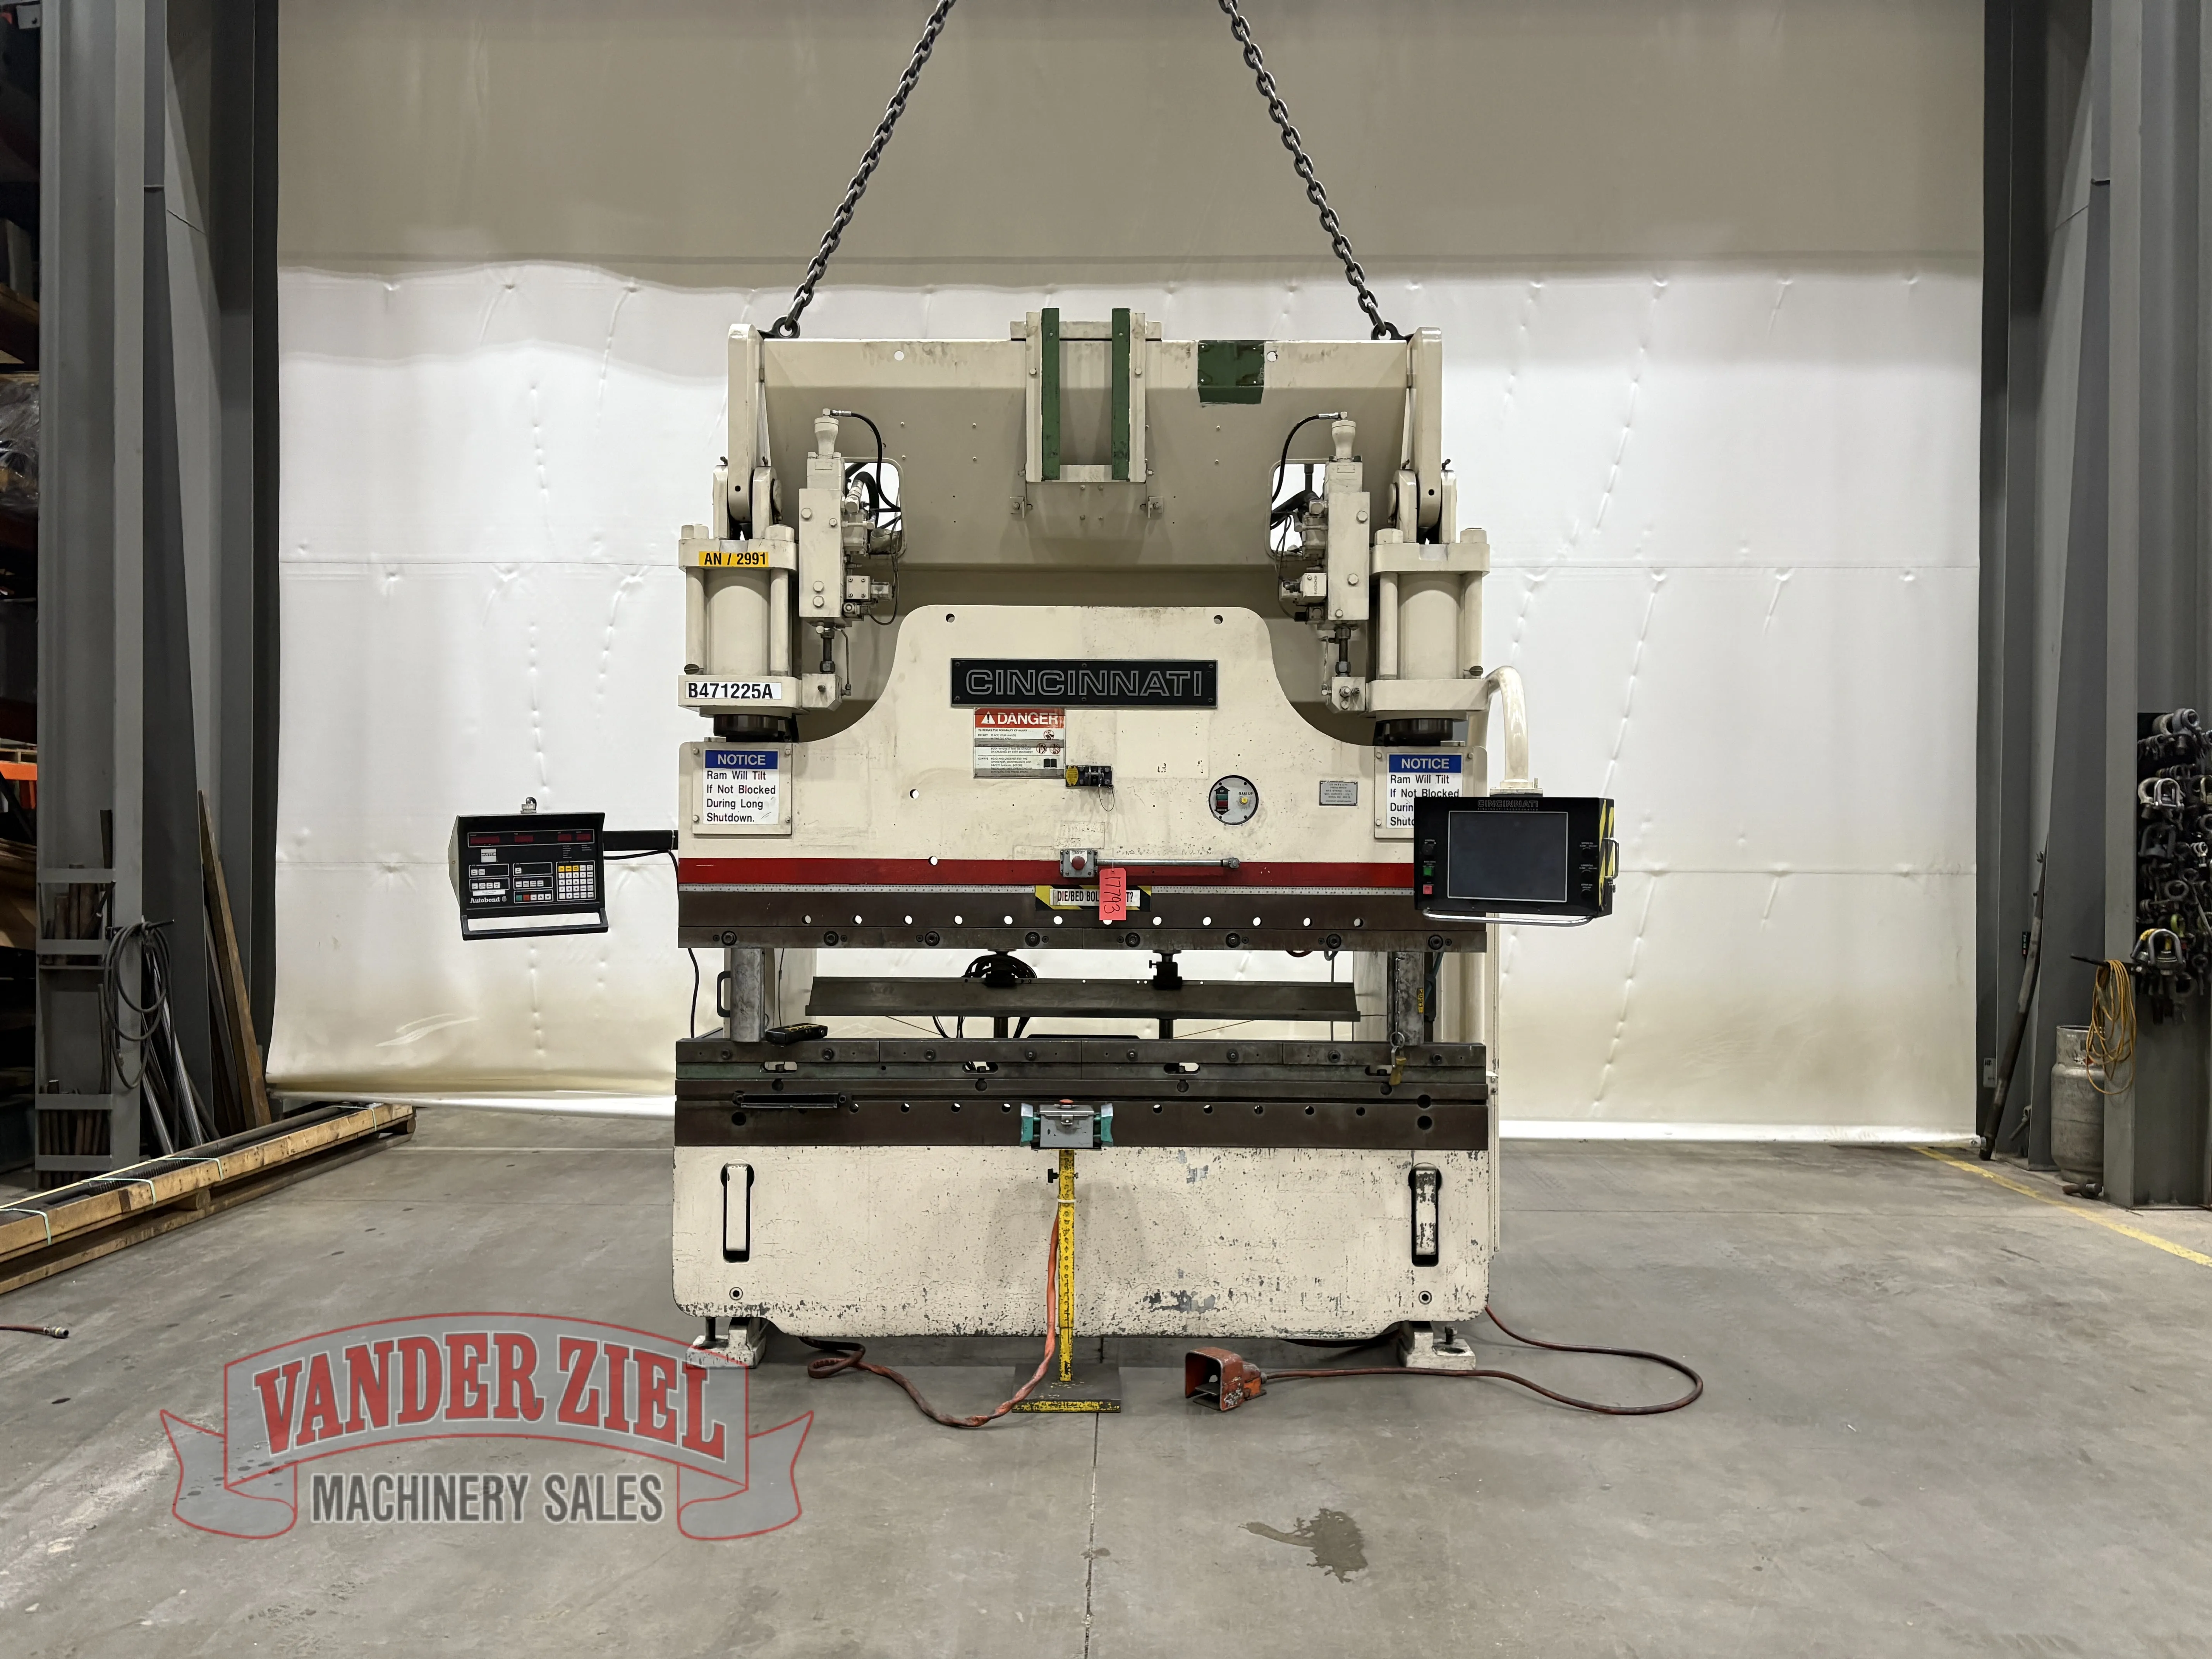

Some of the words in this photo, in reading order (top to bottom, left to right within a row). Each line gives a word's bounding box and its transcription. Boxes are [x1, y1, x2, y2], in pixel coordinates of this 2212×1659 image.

[704, 553, 721, 565] AN
[737, 552, 766, 565] 2991
[966, 669, 1202, 696] CINCINNATI
[689, 683, 773, 699] B471225A
[998, 712, 1058, 725] DANGER
[718, 754, 766, 765] NOTICE
[1401, 758, 1449, 769] NOTICE
[707, 770, 727, 780] Ram
[732, 771, 747, 780] Will
[752, 771, 766, 780] Tilt
[1391, 775, 1410, 784] Ram
[1415, 775, 1431, 784] Will
[1436, 775, 1449, 784] Tilt
[707, 785, 713, 793] If
[718, 785, 733, 794] Not
[738, 785, 776, 794] Blocked
[1391, 788, 1396, 798] If
[1401, 788, 1417, 798] Not
[1422, 788, 1459, 797] Blocked
[707, 799, 735, 809] During
[741, 799, 763, 810] Long
[1390, 802, 1413, 812] Durin
[1477, 800, 1539, 808] CINCINNATI
[707, 812, 754, 822] Shutdown.
[1057, 891, 1084, 902] DIE/BED
[1086, 891, 1099, 902] BOL
[1103, 877, 1121, 914] 17793
